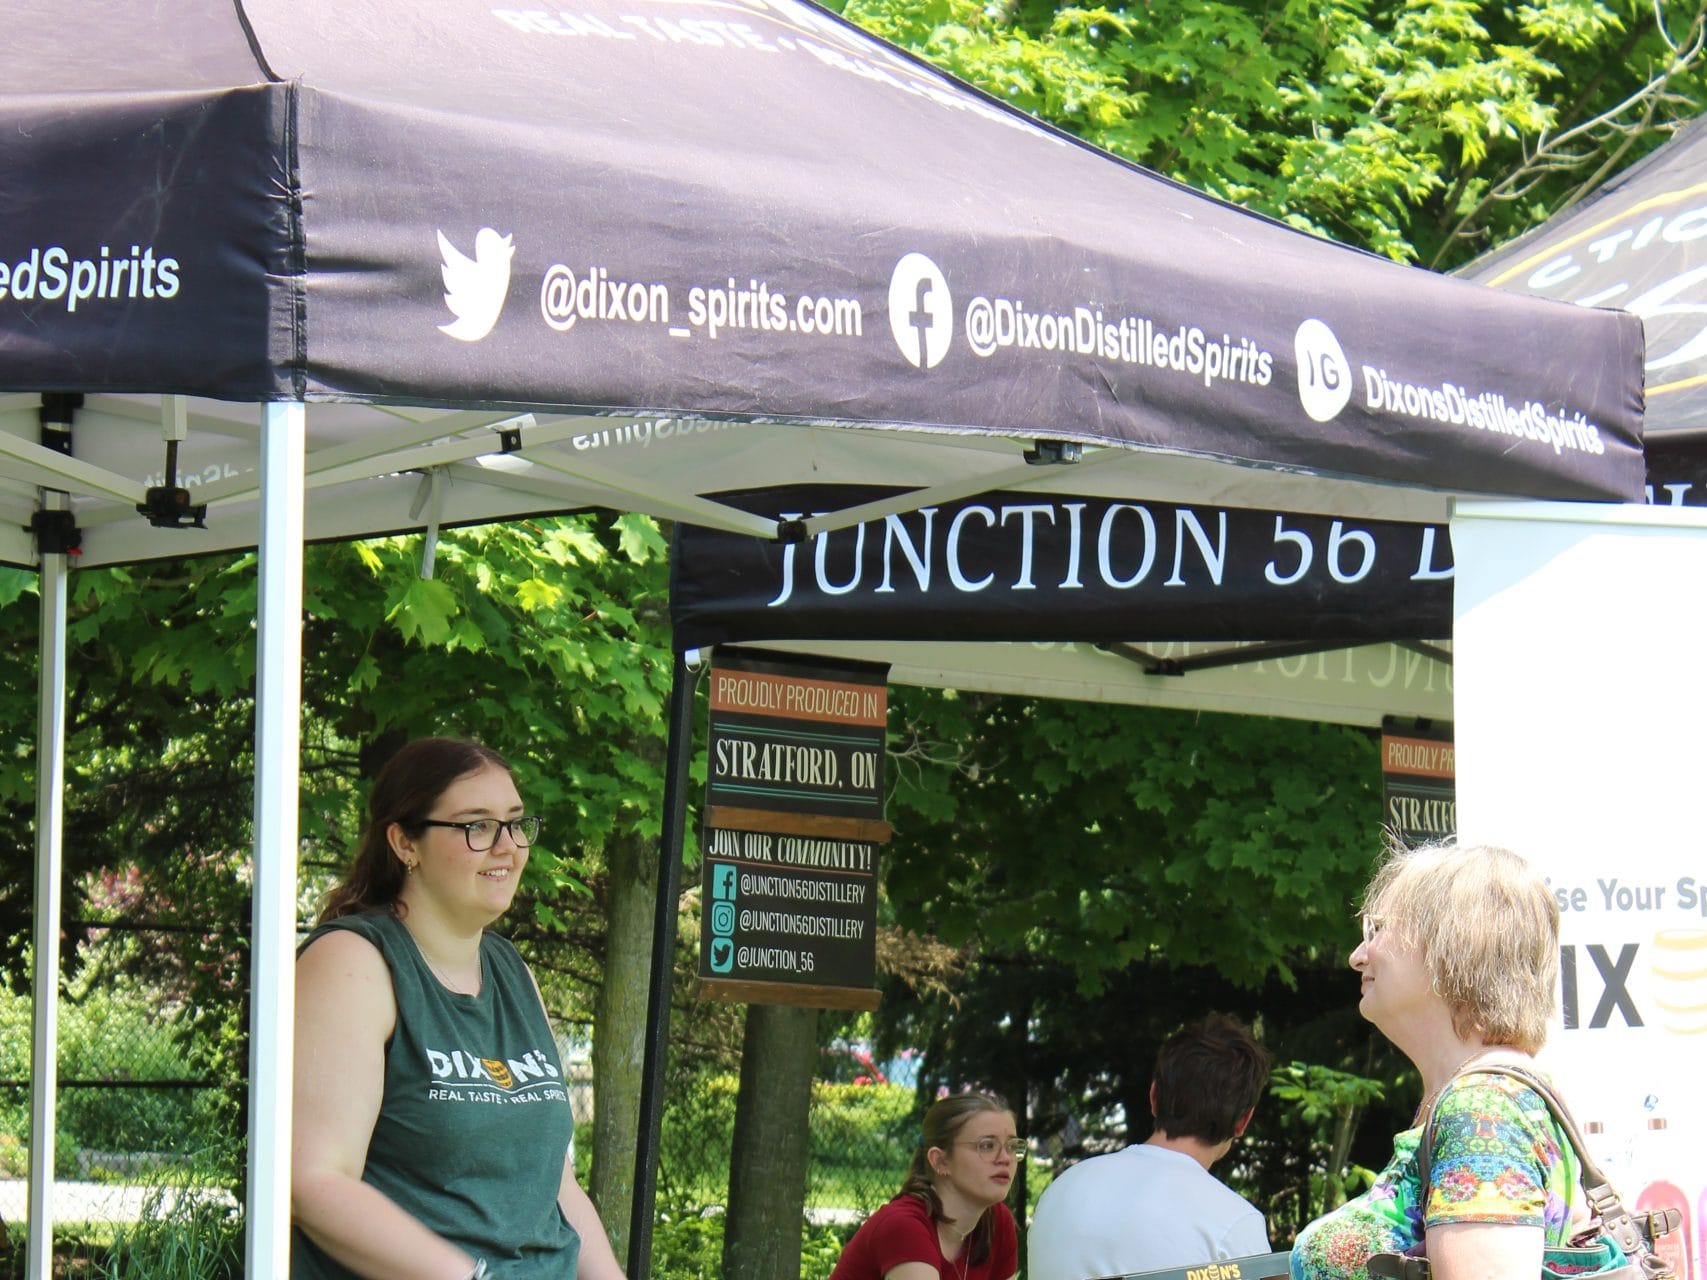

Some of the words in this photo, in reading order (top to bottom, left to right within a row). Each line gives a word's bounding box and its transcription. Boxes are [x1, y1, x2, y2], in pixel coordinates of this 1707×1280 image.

[540, 263, 863, 338] @dixon_spirits.com
[966, 296, 1273, 387] @DixonDistilledSpirits
[1363, 366, 1605, 456] DixonsDistilledSpirits
[767, 503, 1226, 607] JUNCTION
[718, 677, 783, 709] PROUDLY
[786, 685, 859, 717] PRODUCED
[863, 693, 878, 718] IN
[716, 738, 843, 788] STRATFORD,
[851, 751, 877, 789] ON
[1388, 742, 1439, 770] PROUDLY
[709, 829, 740, 858] JOIN
[744, 833, 772, 861] OUR
[777, 837, 872, 870] COMMUNITY!
[740, 873, 866, 904] @JUNCTION56DISTILLERY
[1597, 877, 1667, 912] Your
[739, 909, 864, 939] @JUNCTION56DISTILLERY
[737, 946, 814, 973] @JUNCTION_56
[428, 1089, 465, 1102] REAL
[468, 1091, 503, 1105] TASTE
[510, 1091, 542, 1105] REAL
